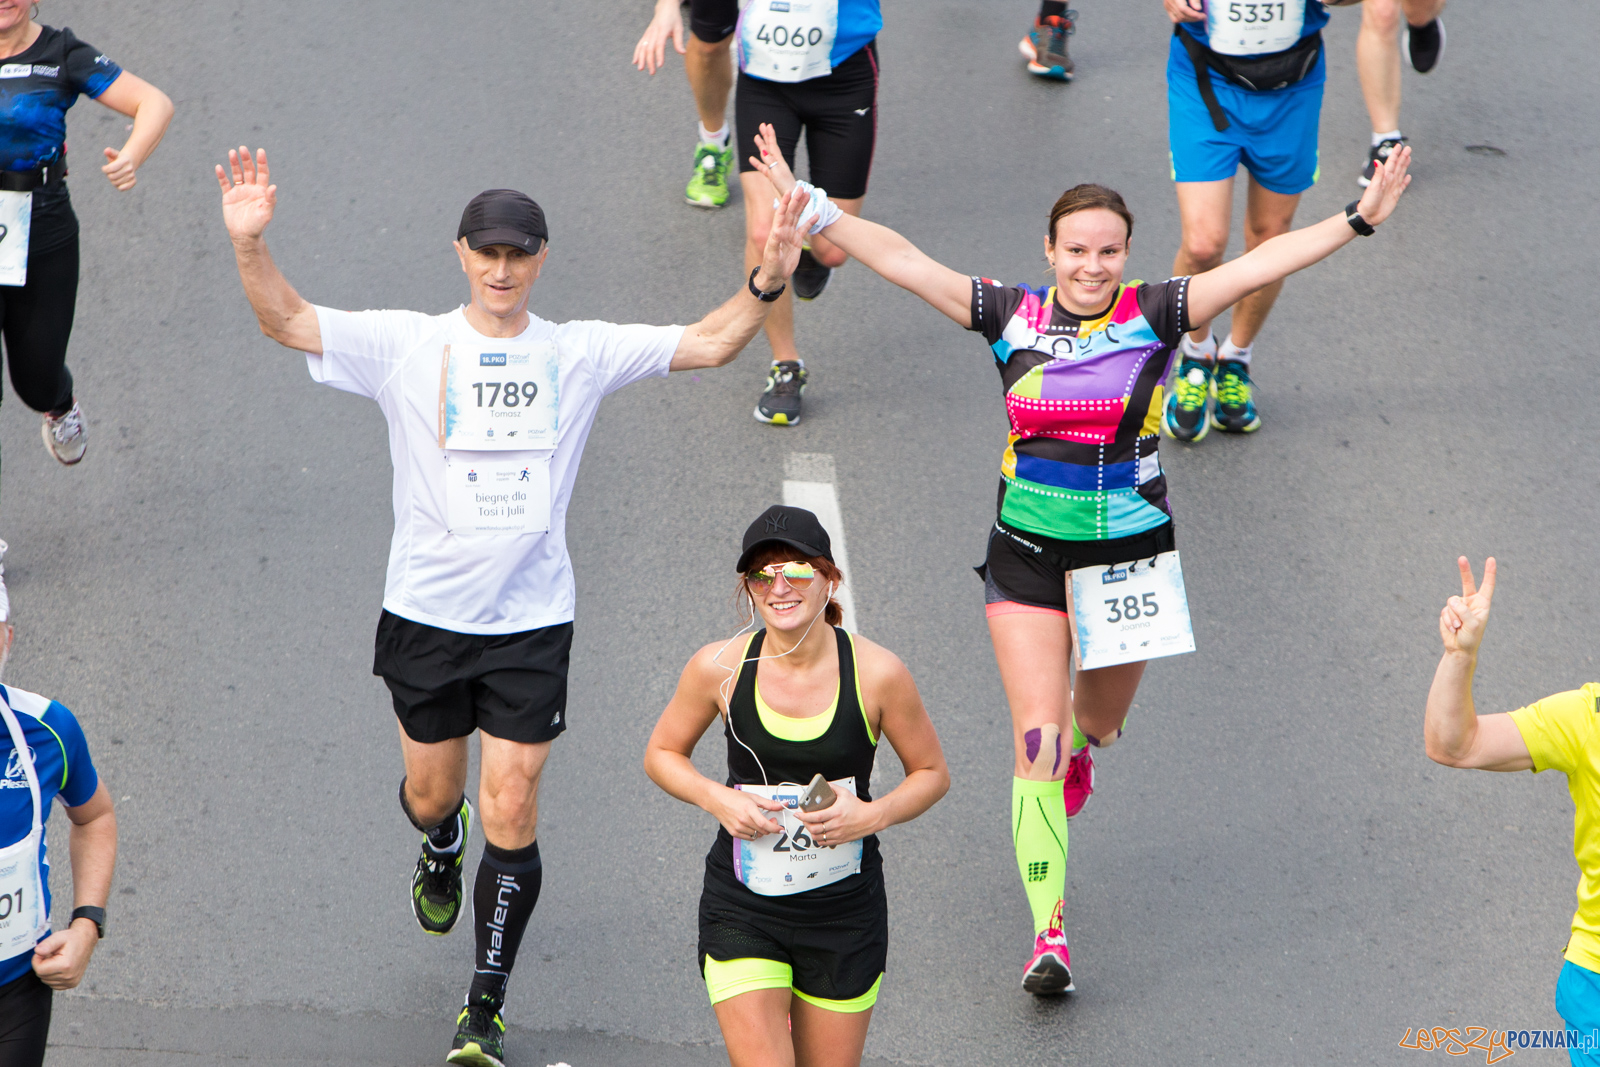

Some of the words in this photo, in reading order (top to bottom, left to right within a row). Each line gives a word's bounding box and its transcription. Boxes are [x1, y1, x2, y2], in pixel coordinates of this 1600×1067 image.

[1228, 2, 1286, 23] 5331
[756, 23, 823, 48] 4060
[472, 381, 538, 408] 1789
[490, 410, 521, 418] Tomasz
[475, 493, 509, 505] biegnę
[512, 491, 527, 501] dla
[478, 507, 498, 517] Tosi
[507, 505, 525, 518] Julii
[1104, 592, 1159, 623] 385
[1120, 621, 1151, 632] Joanna
[789, 853, 817, 862] Marta
